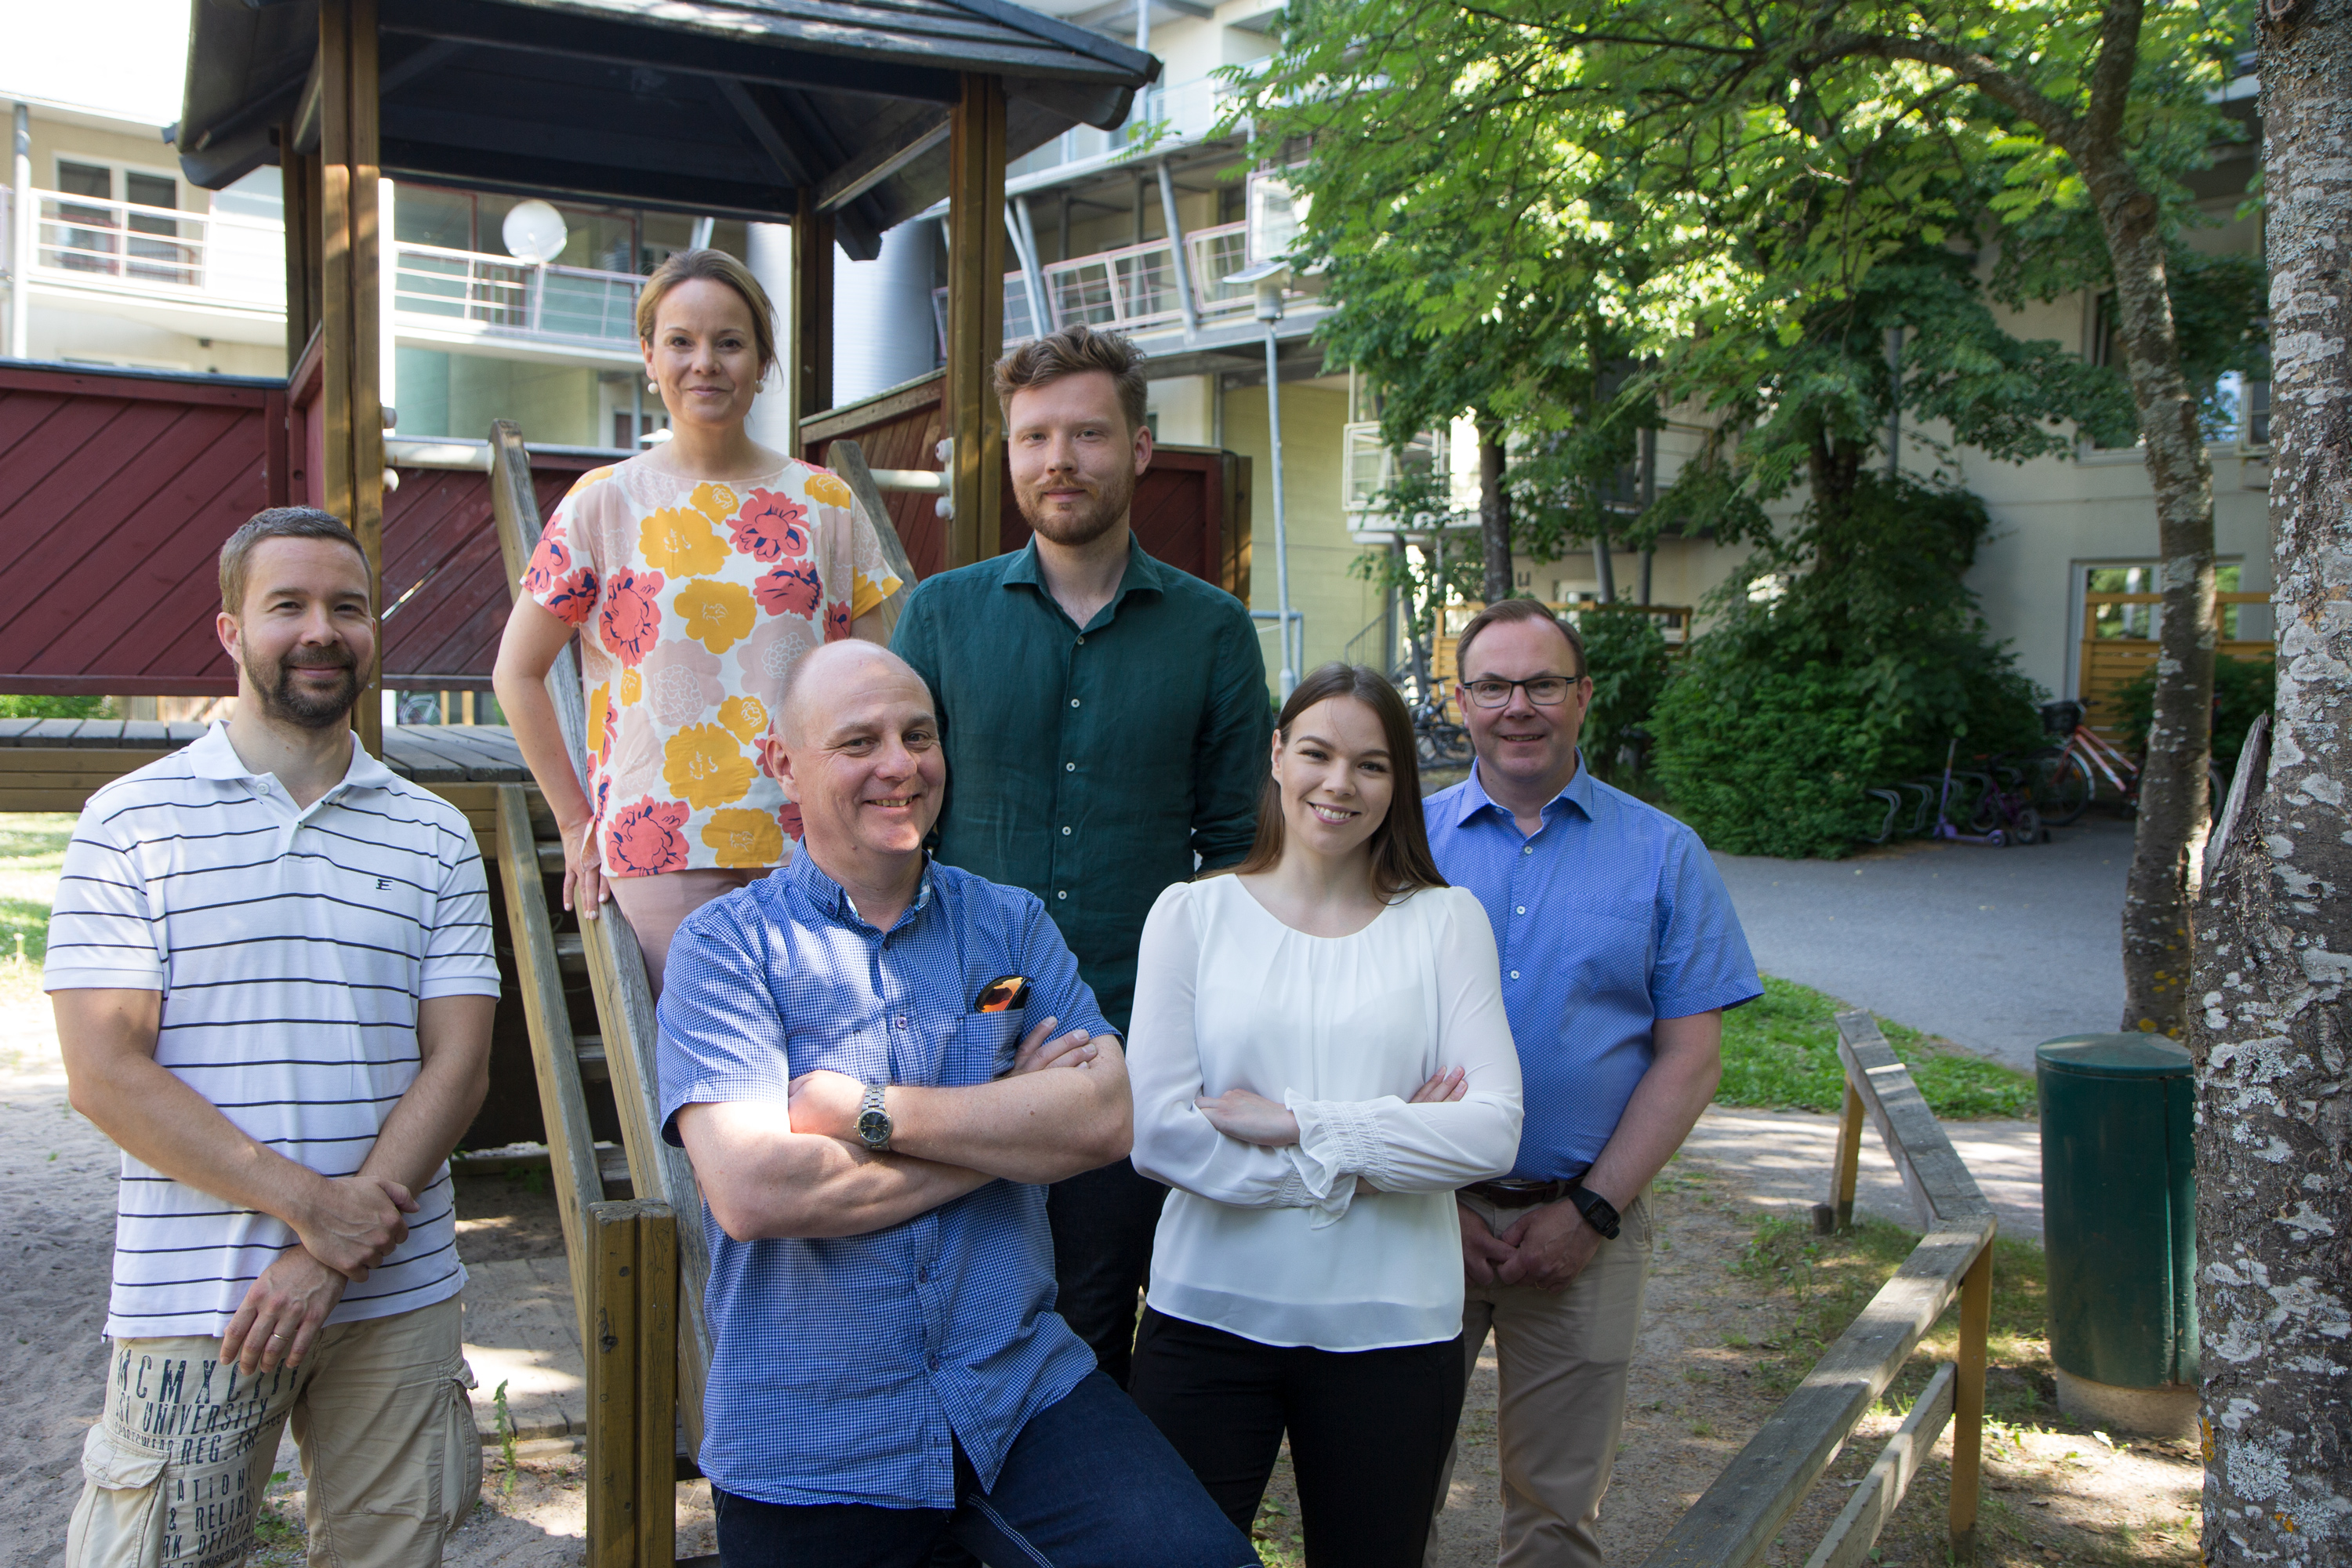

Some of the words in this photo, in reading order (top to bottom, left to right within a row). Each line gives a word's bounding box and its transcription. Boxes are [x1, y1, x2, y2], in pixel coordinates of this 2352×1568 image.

[143, 1397, 268, 1436] UNIVERSITY
[180, 1434, 229, 1465] REG.
[169, 1507, 178, 1531] &
